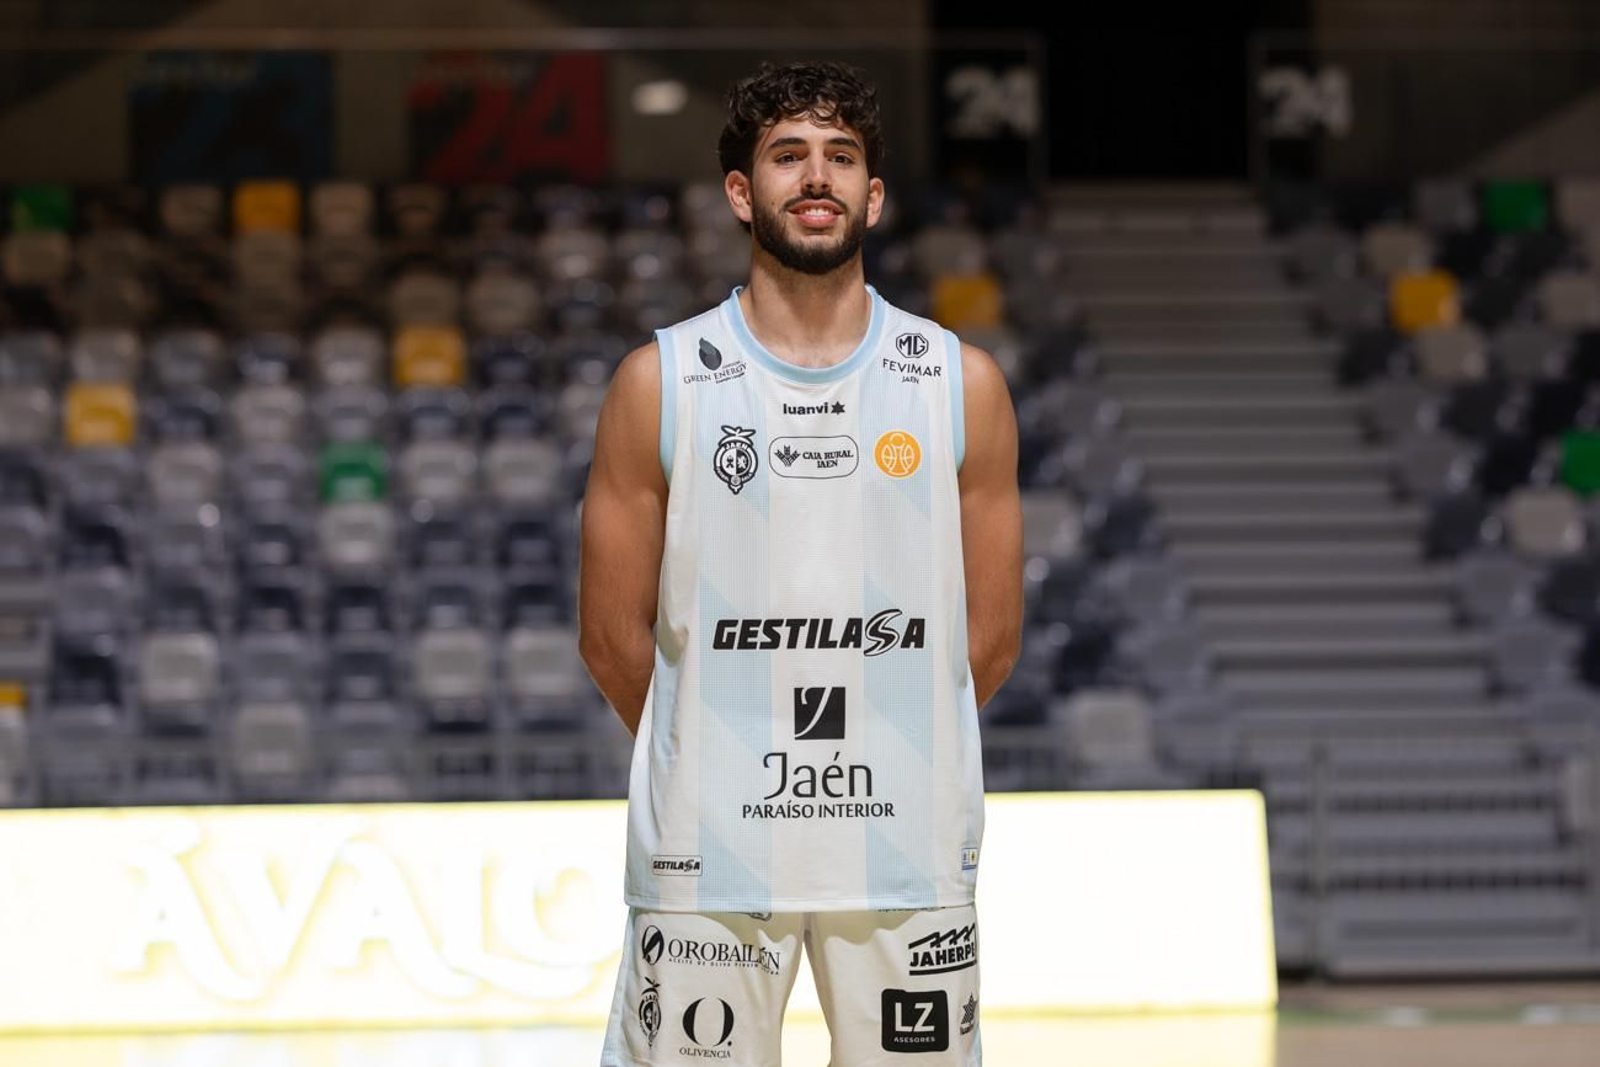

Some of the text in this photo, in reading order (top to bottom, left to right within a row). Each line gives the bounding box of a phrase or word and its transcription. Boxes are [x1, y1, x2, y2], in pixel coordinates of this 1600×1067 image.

[900, 335, 926, 356] MG
[683, 374, 711, 385] GREEN
[713, 362, 748, 380] ENERGY
[883, 358, 942, 377] FEVIMAR
[783, 402, 829, 415] luanvi
[824, 450, 854, 460] RURAL
[713, 608, 926, 657] GESTILASA
[763, 751, 873, 801] Jaén
[742, 800, 896, 819] PARAÍSO INTERIOR
[653, 859, 700, 872] GESTILASA
[895, 1002, 935, 1032] LZ
[679, 1047, 731, 1058] OLIVENCIA
